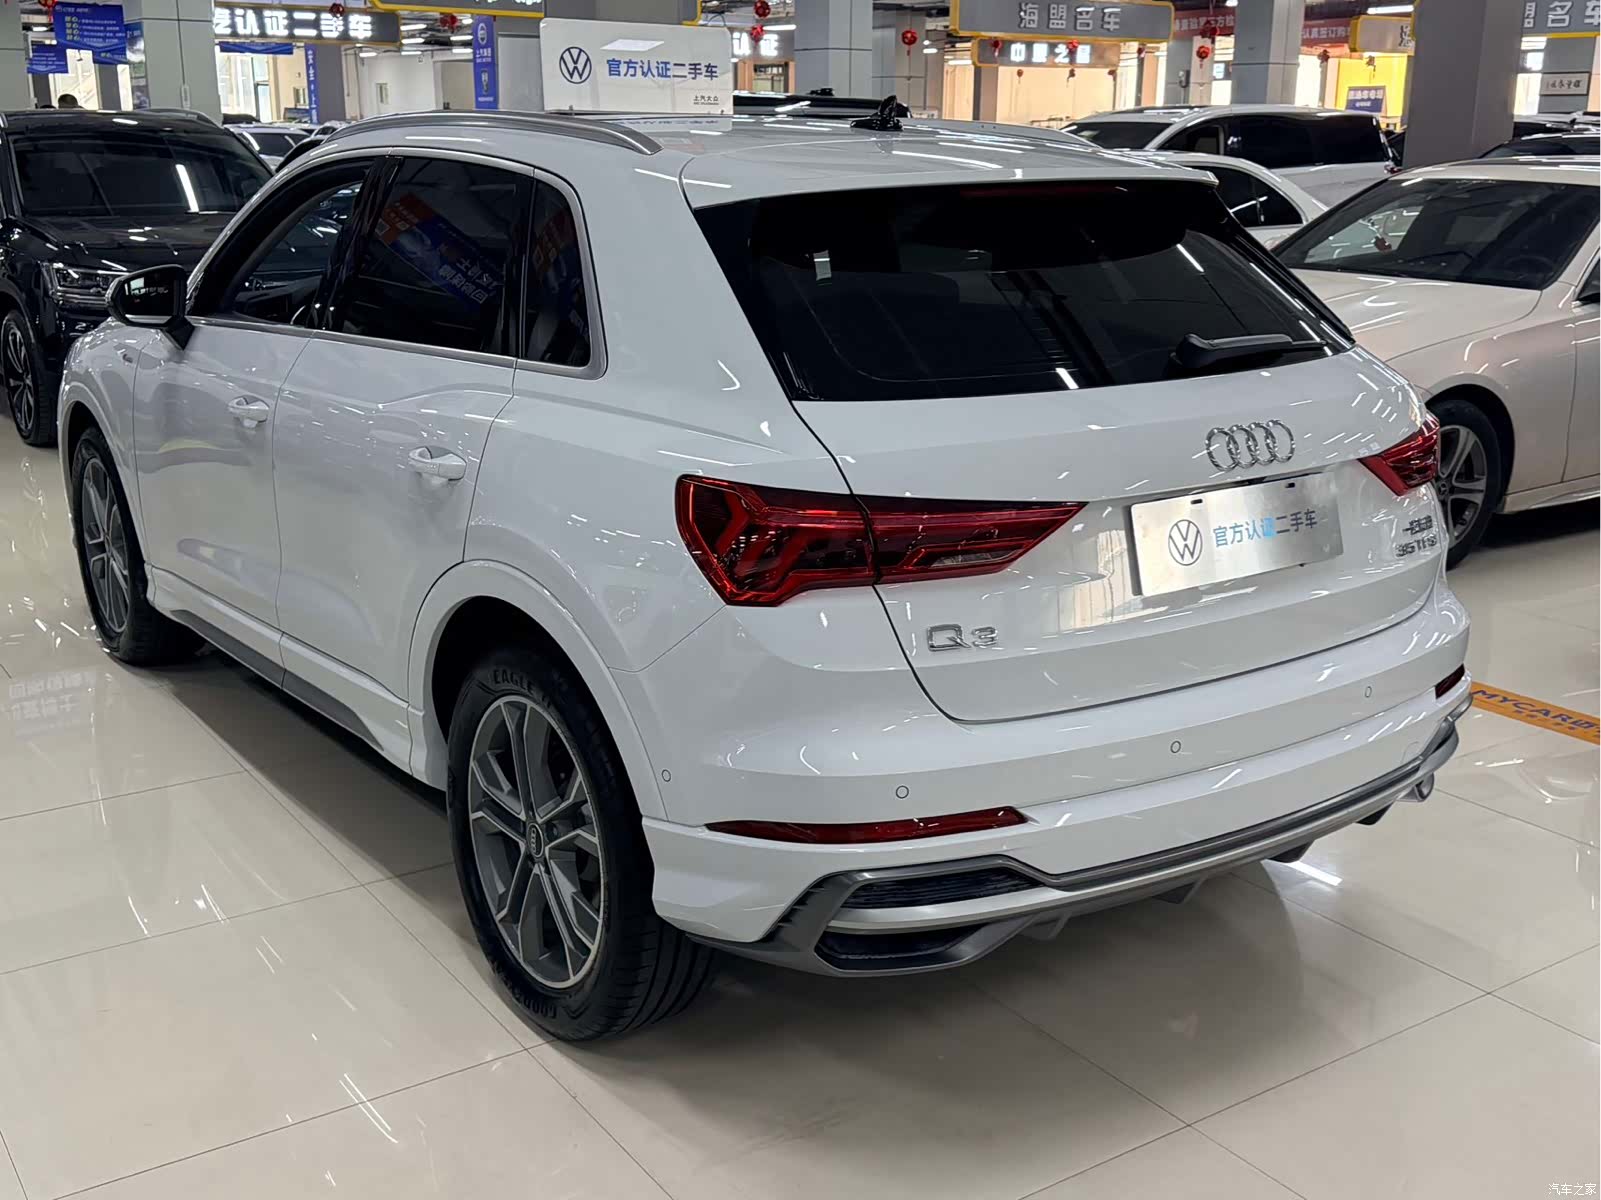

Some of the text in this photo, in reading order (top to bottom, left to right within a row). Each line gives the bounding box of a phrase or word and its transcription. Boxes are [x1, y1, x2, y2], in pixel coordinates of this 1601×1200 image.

[1019, 3, 1121, 31] 海盟名车
[606, 58, 719, 81] 官方认证二手车
[1213, 508, 1318, 548] 官方认证二手车
[927, 624, 998, 652] Q3
